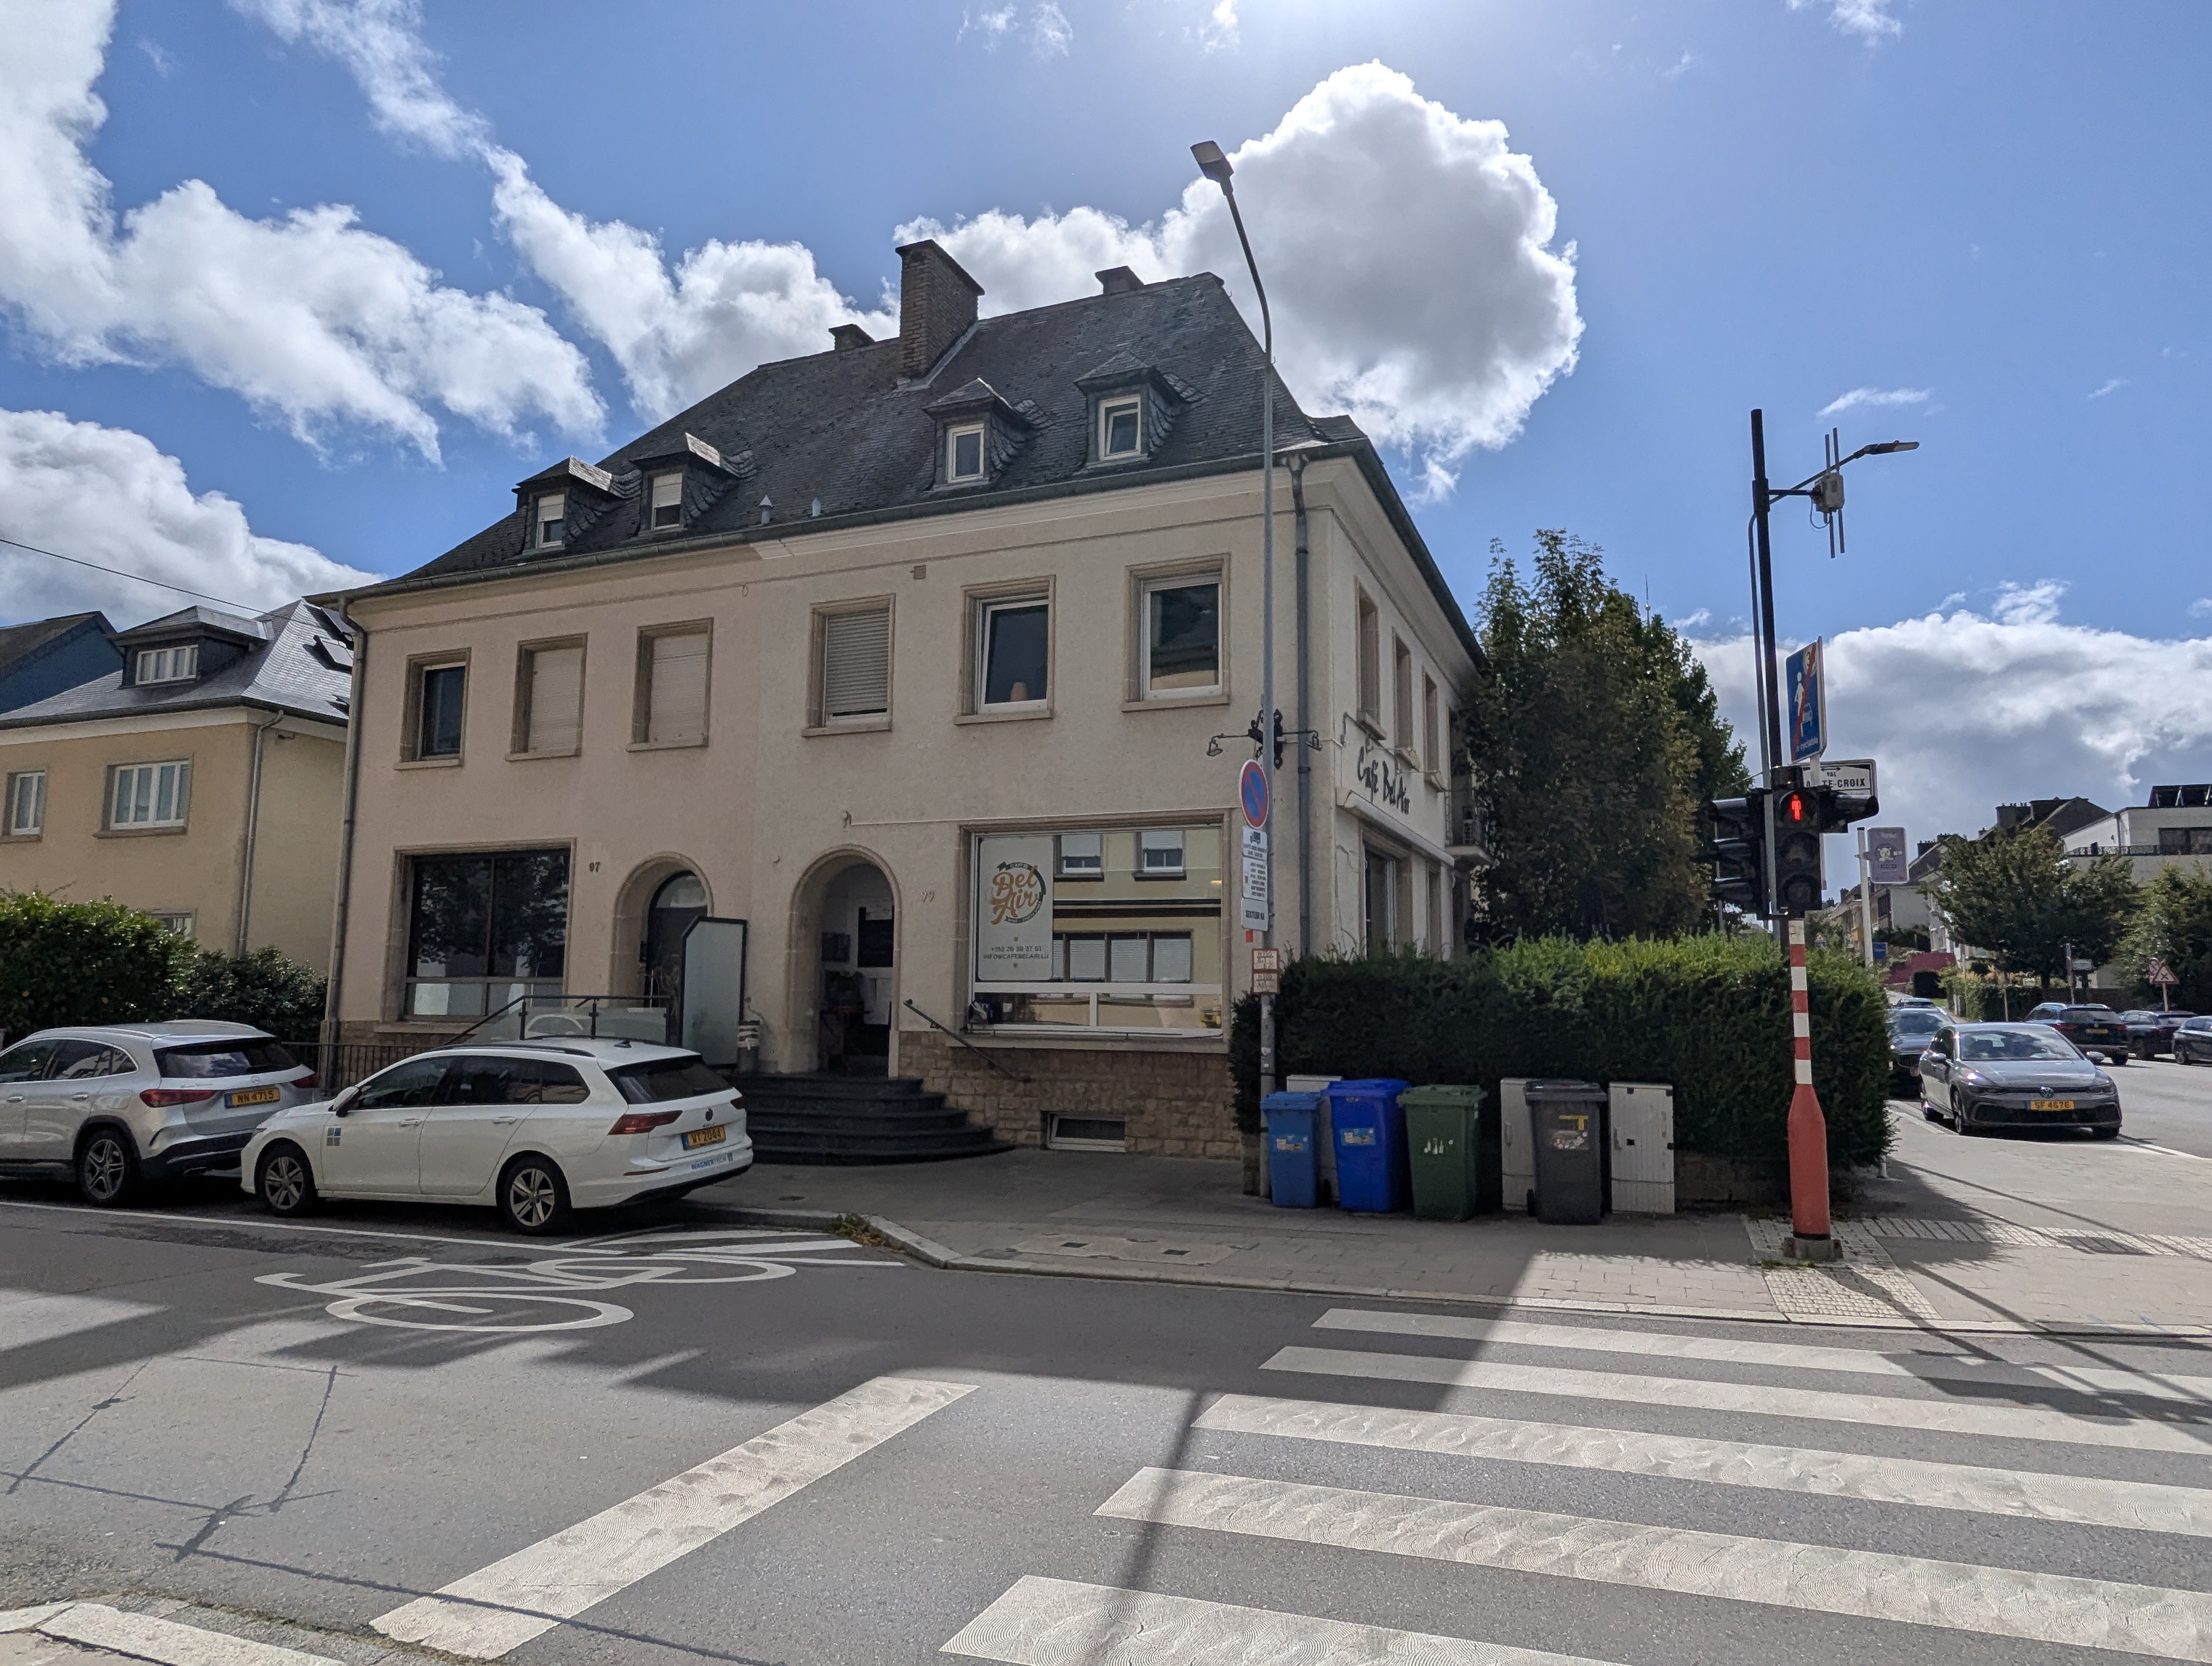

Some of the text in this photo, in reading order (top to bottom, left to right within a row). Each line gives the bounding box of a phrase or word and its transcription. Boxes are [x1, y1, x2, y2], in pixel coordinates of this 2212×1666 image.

[589, 862, 600, 873] 97
[992, 866, 1038, 905] Bel
[991, 888, 1038, 925] Air
